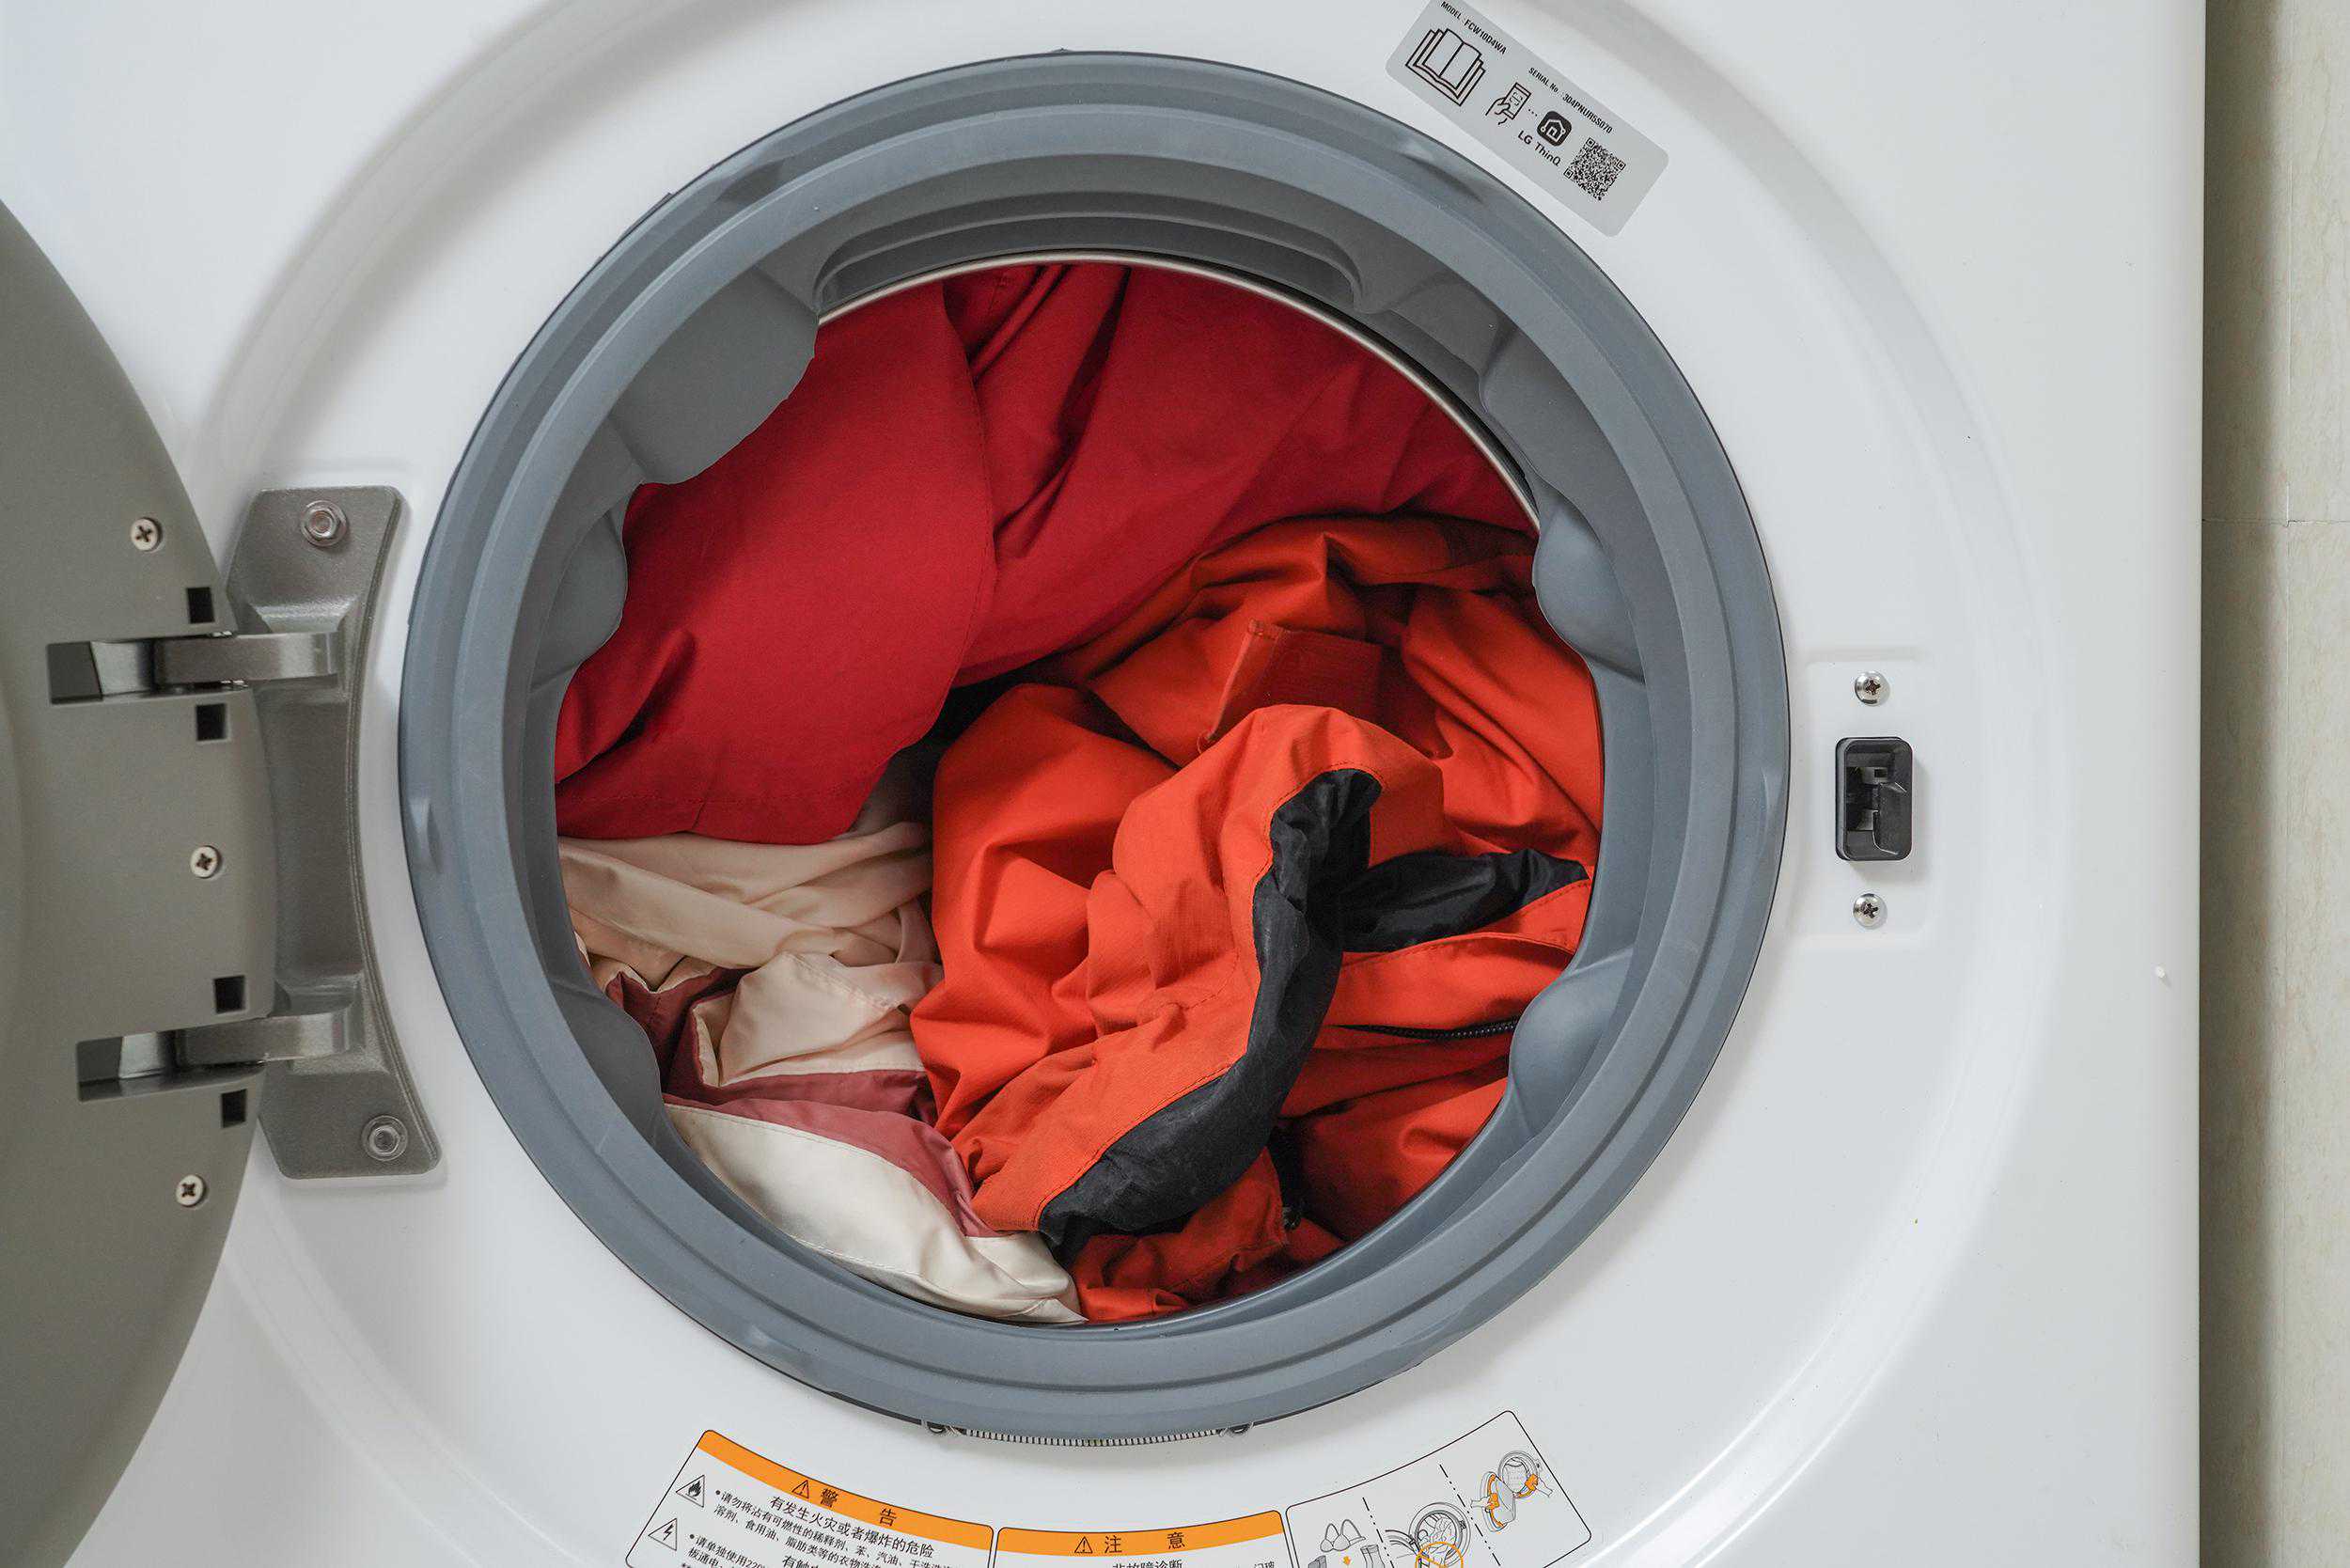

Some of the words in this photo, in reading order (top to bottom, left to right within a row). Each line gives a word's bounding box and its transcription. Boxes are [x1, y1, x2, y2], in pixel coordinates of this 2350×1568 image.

[1440, 1, 1462, 19] MODEL
[1528, 67, 1550, 86] SERIAL
[1518, 131, 1533, 145] LG
[1535, 142, 1560, 166] ThinQ
[770, 1496, 934, 1559] 有发生火灾或者爆炸的危险
